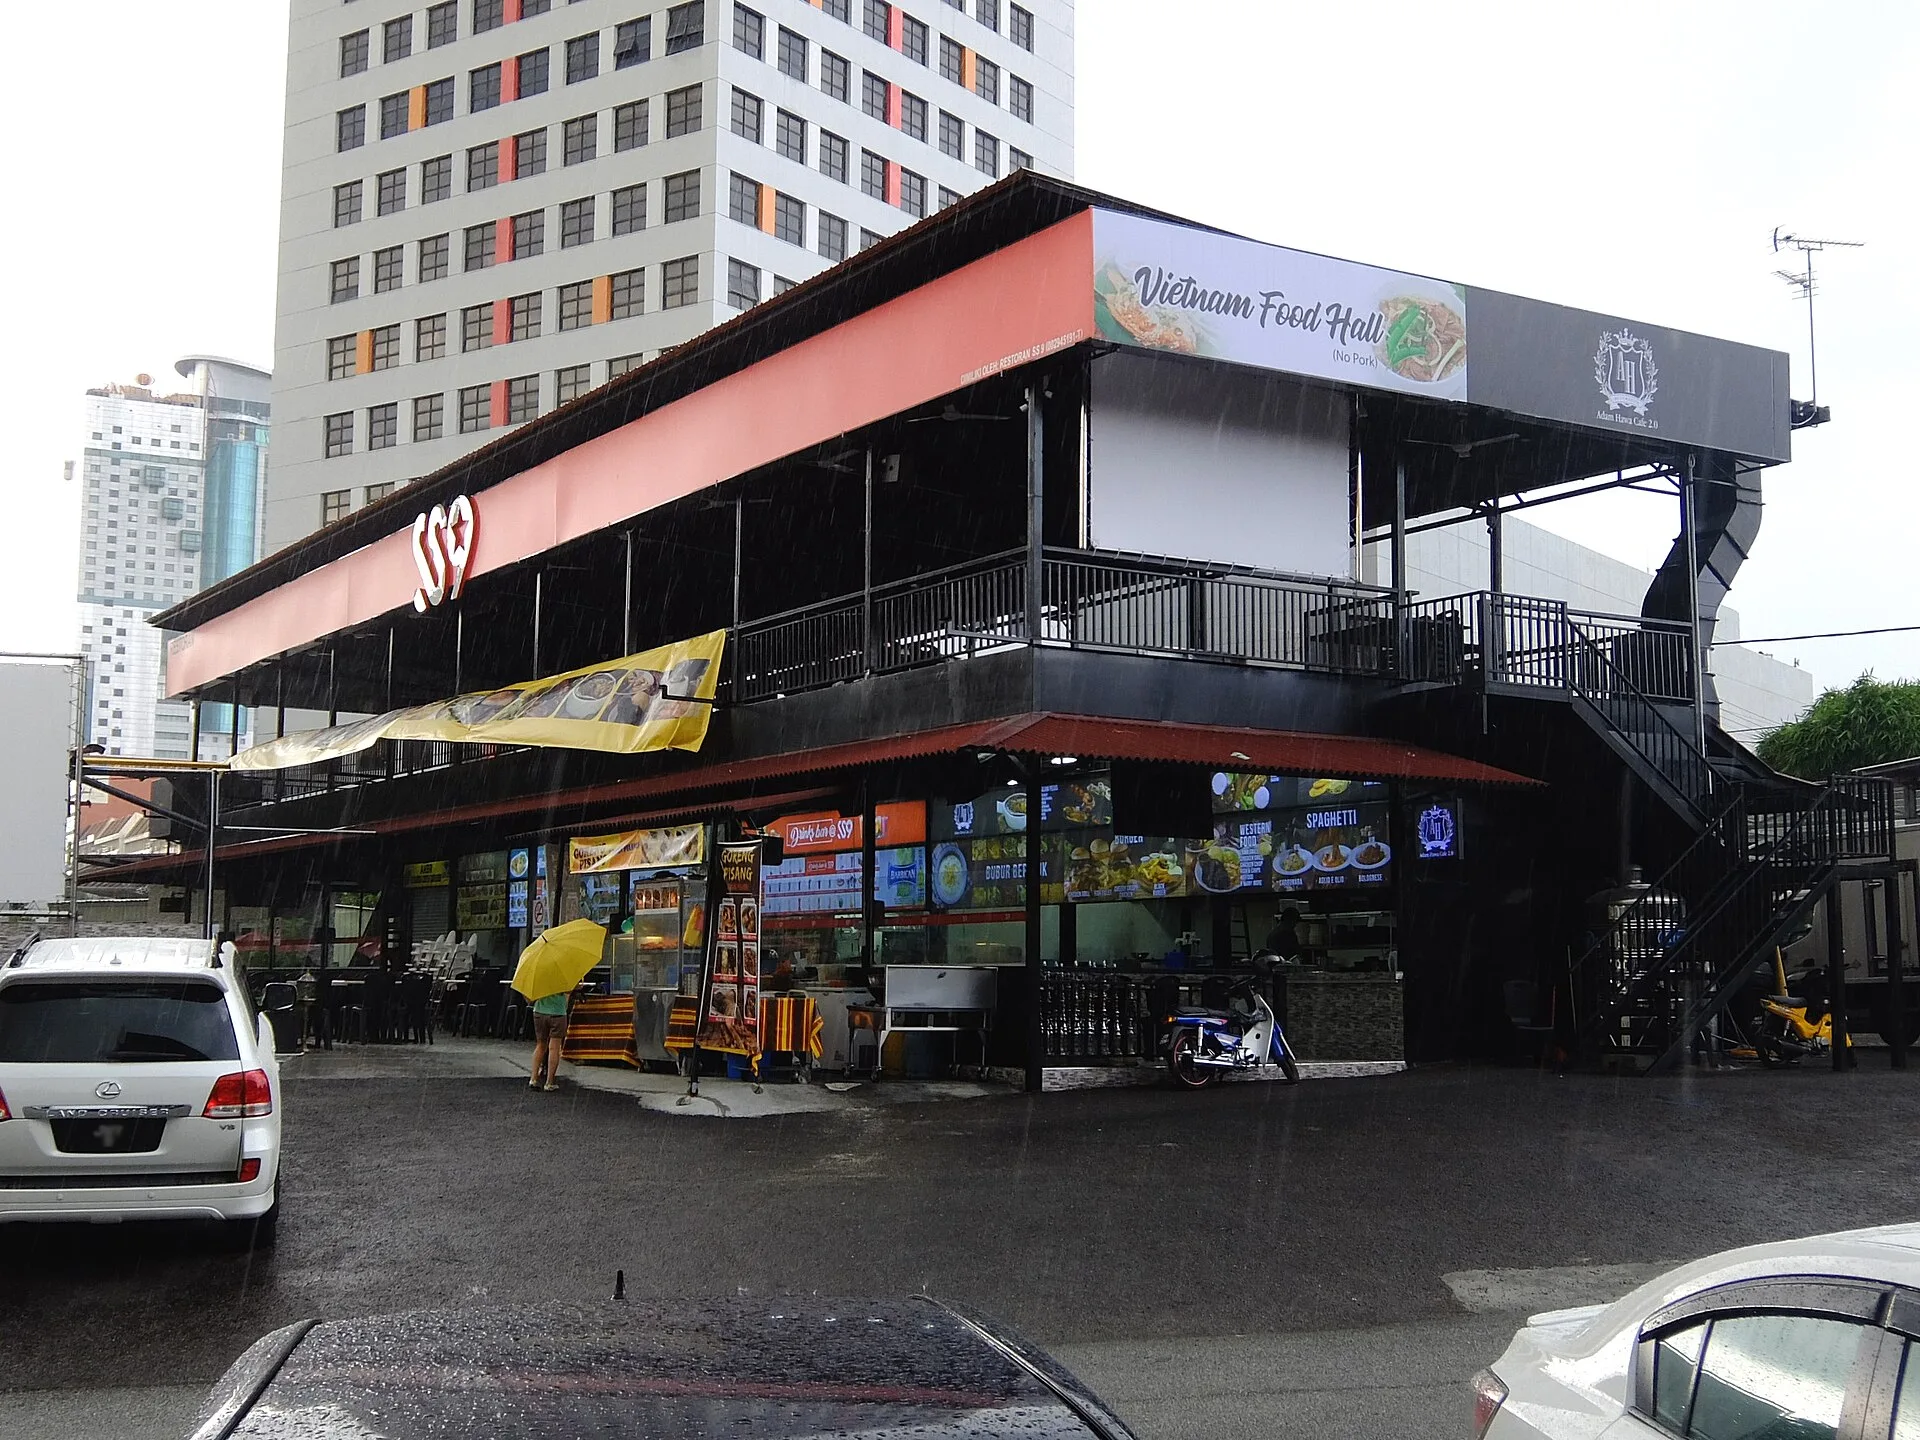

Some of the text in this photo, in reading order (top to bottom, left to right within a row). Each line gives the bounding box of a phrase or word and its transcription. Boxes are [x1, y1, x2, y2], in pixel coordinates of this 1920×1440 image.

[1134, 266, 1384, 346] Vietnam Food Hall
[999, 348, 1031, 369] RESTORAN
[1333, 349, 1378, 369] (No Pork)
[1306, 809, 1357, 829] SPAGHETTI
[1239, 820, 1272, 836] WESTERN
[1239, 835, 1257, 848] FOOD
[721, 850, 755, 864] GORENG
[724, 867, 753, 881] PISANG
[890, 868, 916, 880] BARBICAN
[985, 864, 1011, 880] BUBUR
[46, 1108, 169, 1118] LAND CRUISER
